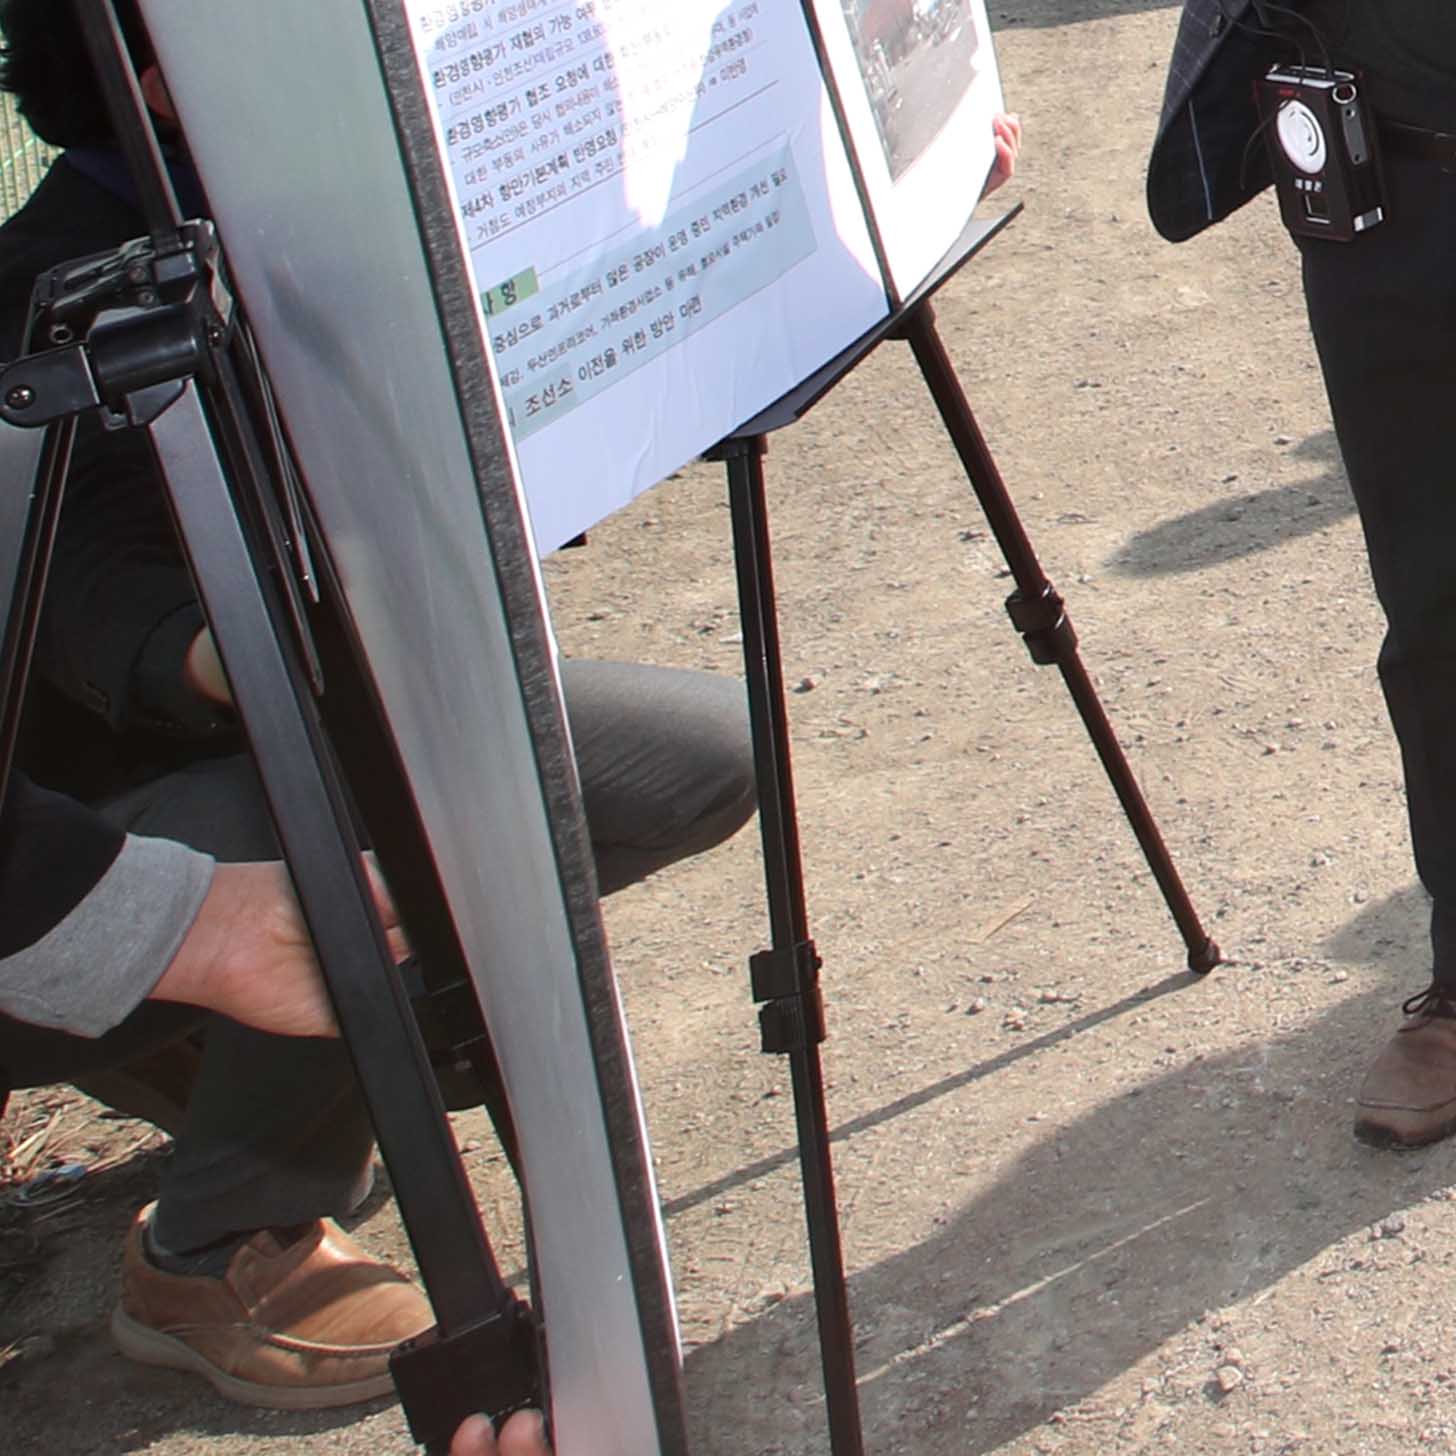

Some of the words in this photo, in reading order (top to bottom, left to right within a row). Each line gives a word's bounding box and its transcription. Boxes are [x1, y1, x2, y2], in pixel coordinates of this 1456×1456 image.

[432, 42, 506, 89] 환경영향평가
[445, 96, 521, 146] 환경영향평가
[526, 82, 551, 107] 협조
[554, 64, 589, 93] 요청에
[493, 313, 543, 354] 중심으로
[547, 279, 602, 323] 과거로부터
[524, 374, 573, 418] 조선소
[577, 346, 617, 385] 이전을
[621, 329, 647, 358] 위한
[650, 311, 676, 341] 방안
